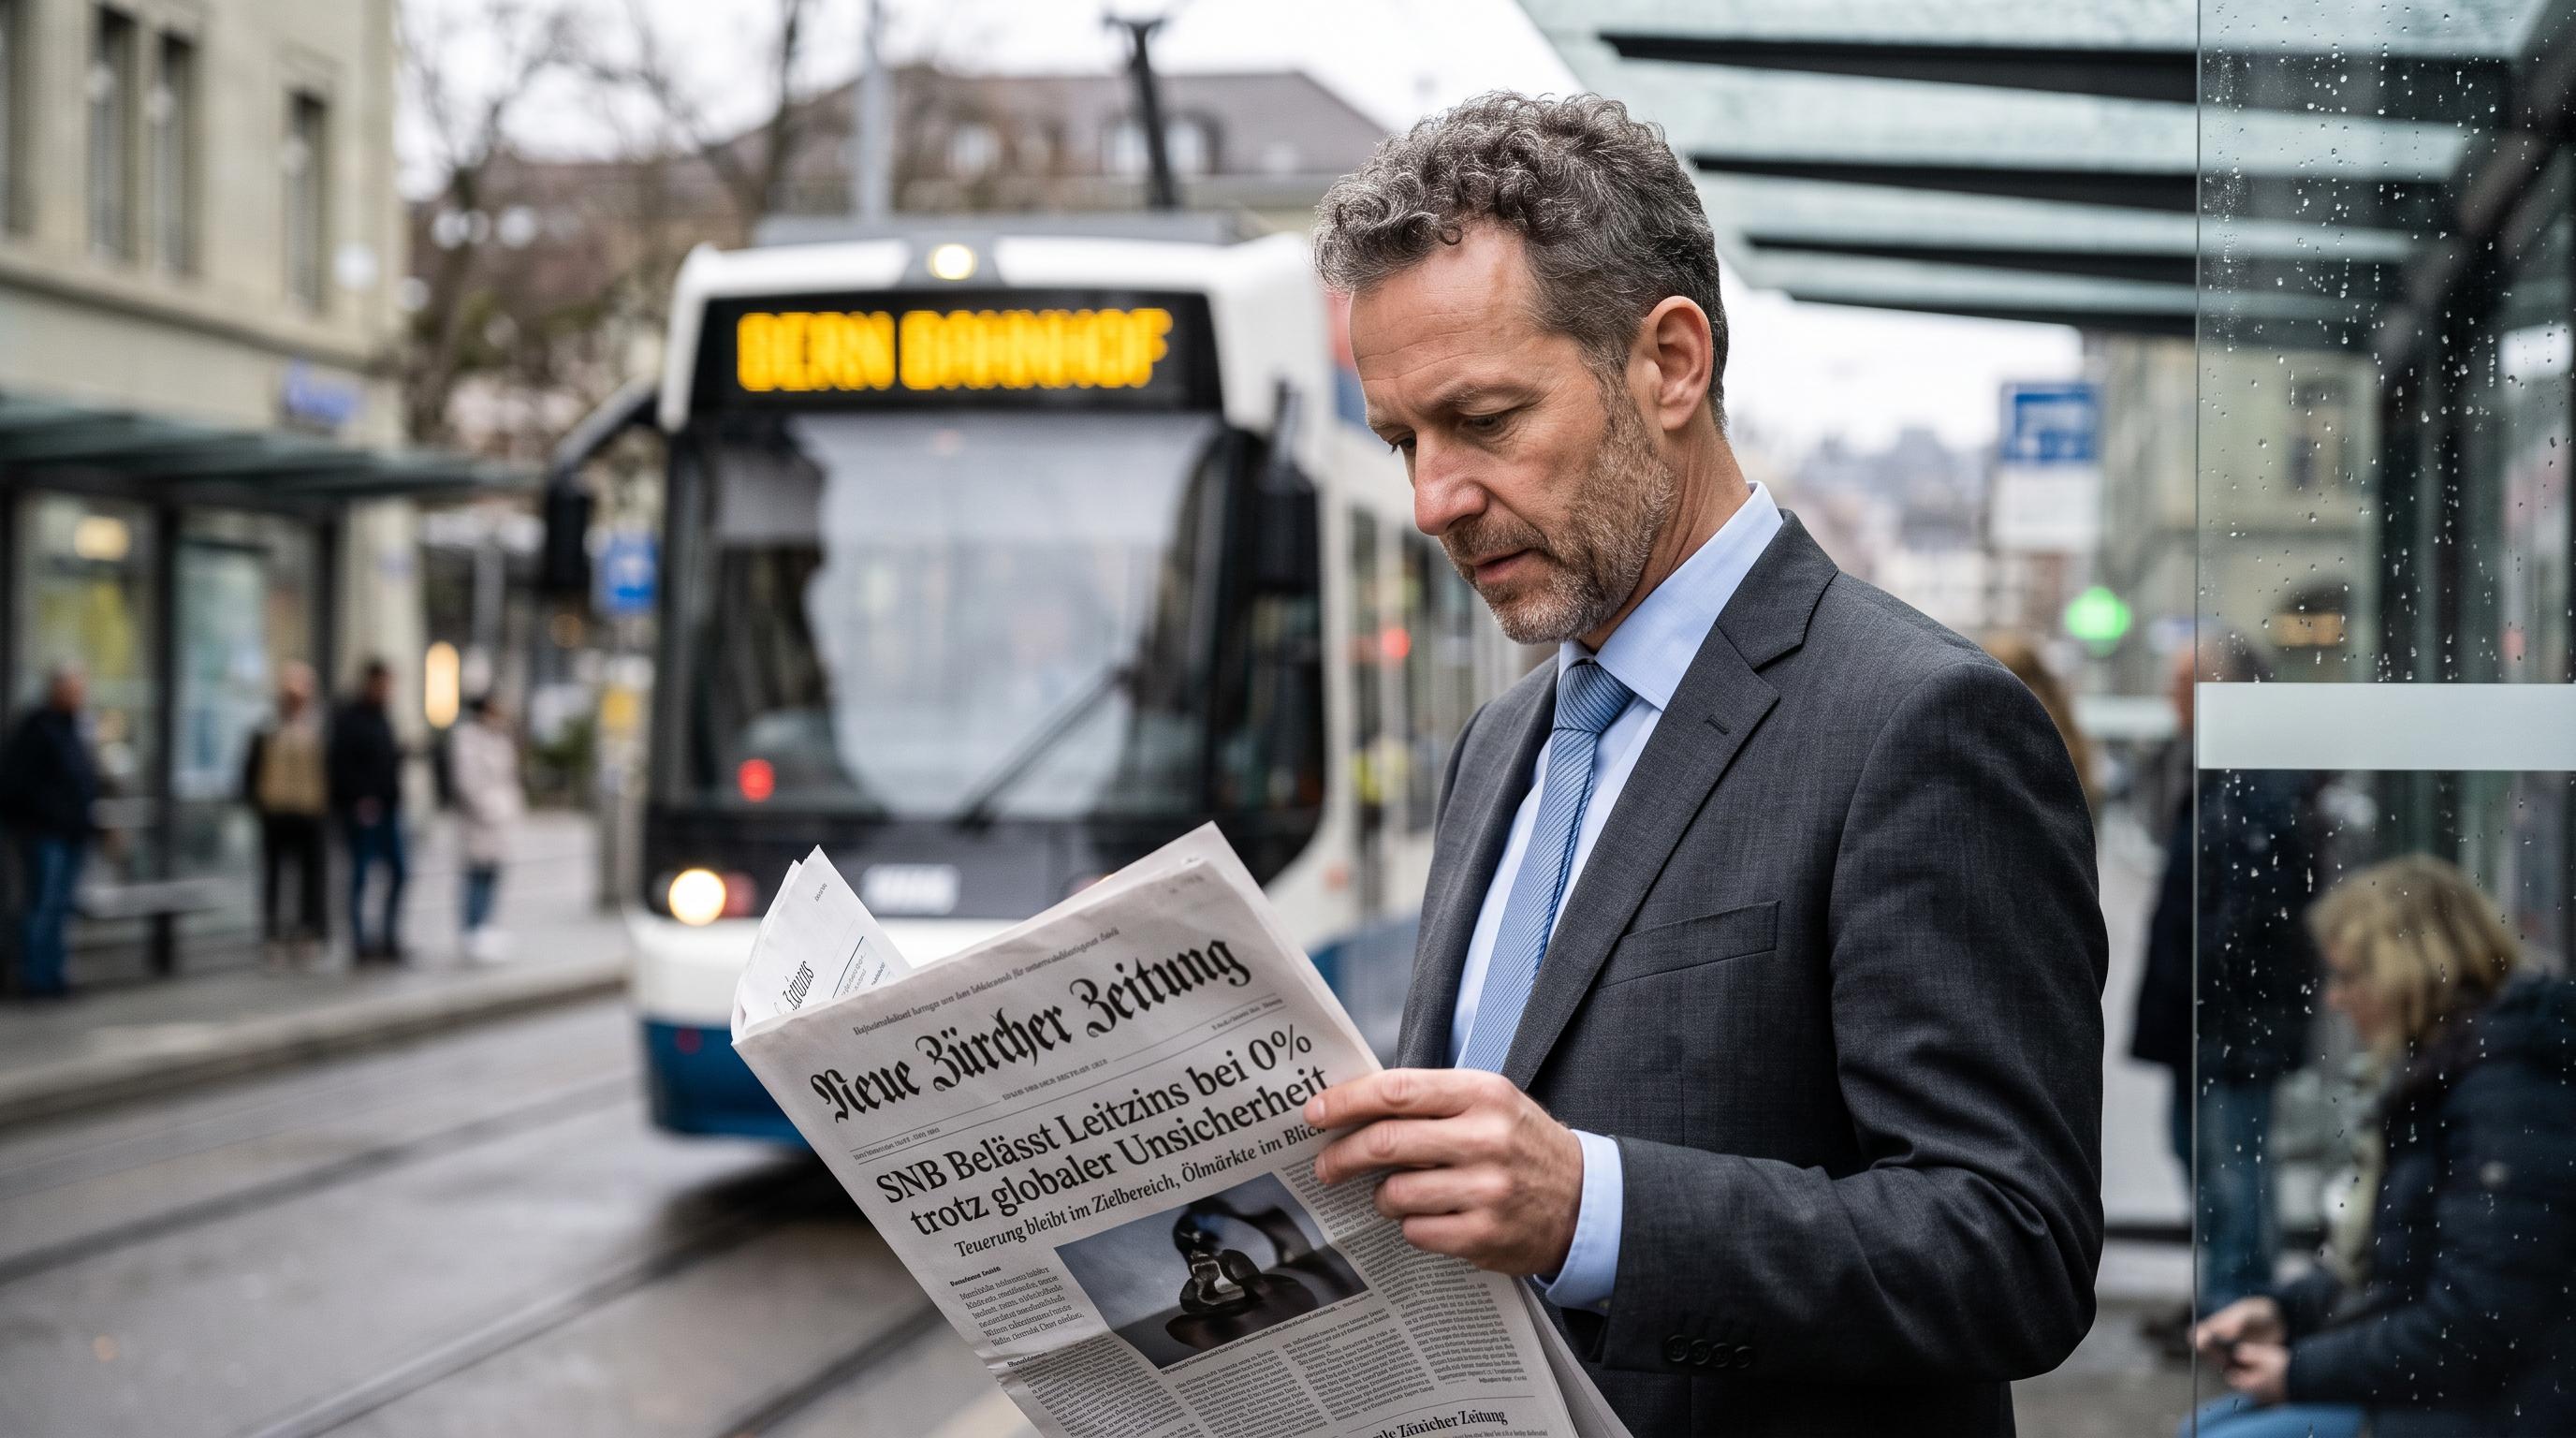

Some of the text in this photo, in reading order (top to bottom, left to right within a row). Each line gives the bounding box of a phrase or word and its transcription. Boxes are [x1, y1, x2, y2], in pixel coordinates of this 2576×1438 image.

[737, 312, 896, 391] BERN
[811, 1060, 922, 1124] Neue
[915, 1007, 1073, 1093] Zürcher
[1069, 939, 1252, 1038] Zeitung
[875, 1159, 948, 1205] SNB
[943, 1123, 1061, 1182] Belässt
[1054, 1082, 1191, 1146] Leitzins
[1185, 1049, 1251, 1097] bei
[1248, 1022, 1313, 1072] 0%
[910, 1196, 991, 1237] trotz
[990, 1152, 1119, 1218] globaler
[1113, 1064, 1328, 1167] Unsicherheit
[953, 1225, 1028, 1257] Teuerung
[1023, 1210, 1068, 1236] bleibt
[1068, 1204, 1091, 1222] im
[1091, 1173, 1181, 1214] Zielbereich,
[1180, 1148, 1257, 1183] Ölmärkte
[1257, 1138, 1283, 1156] im
